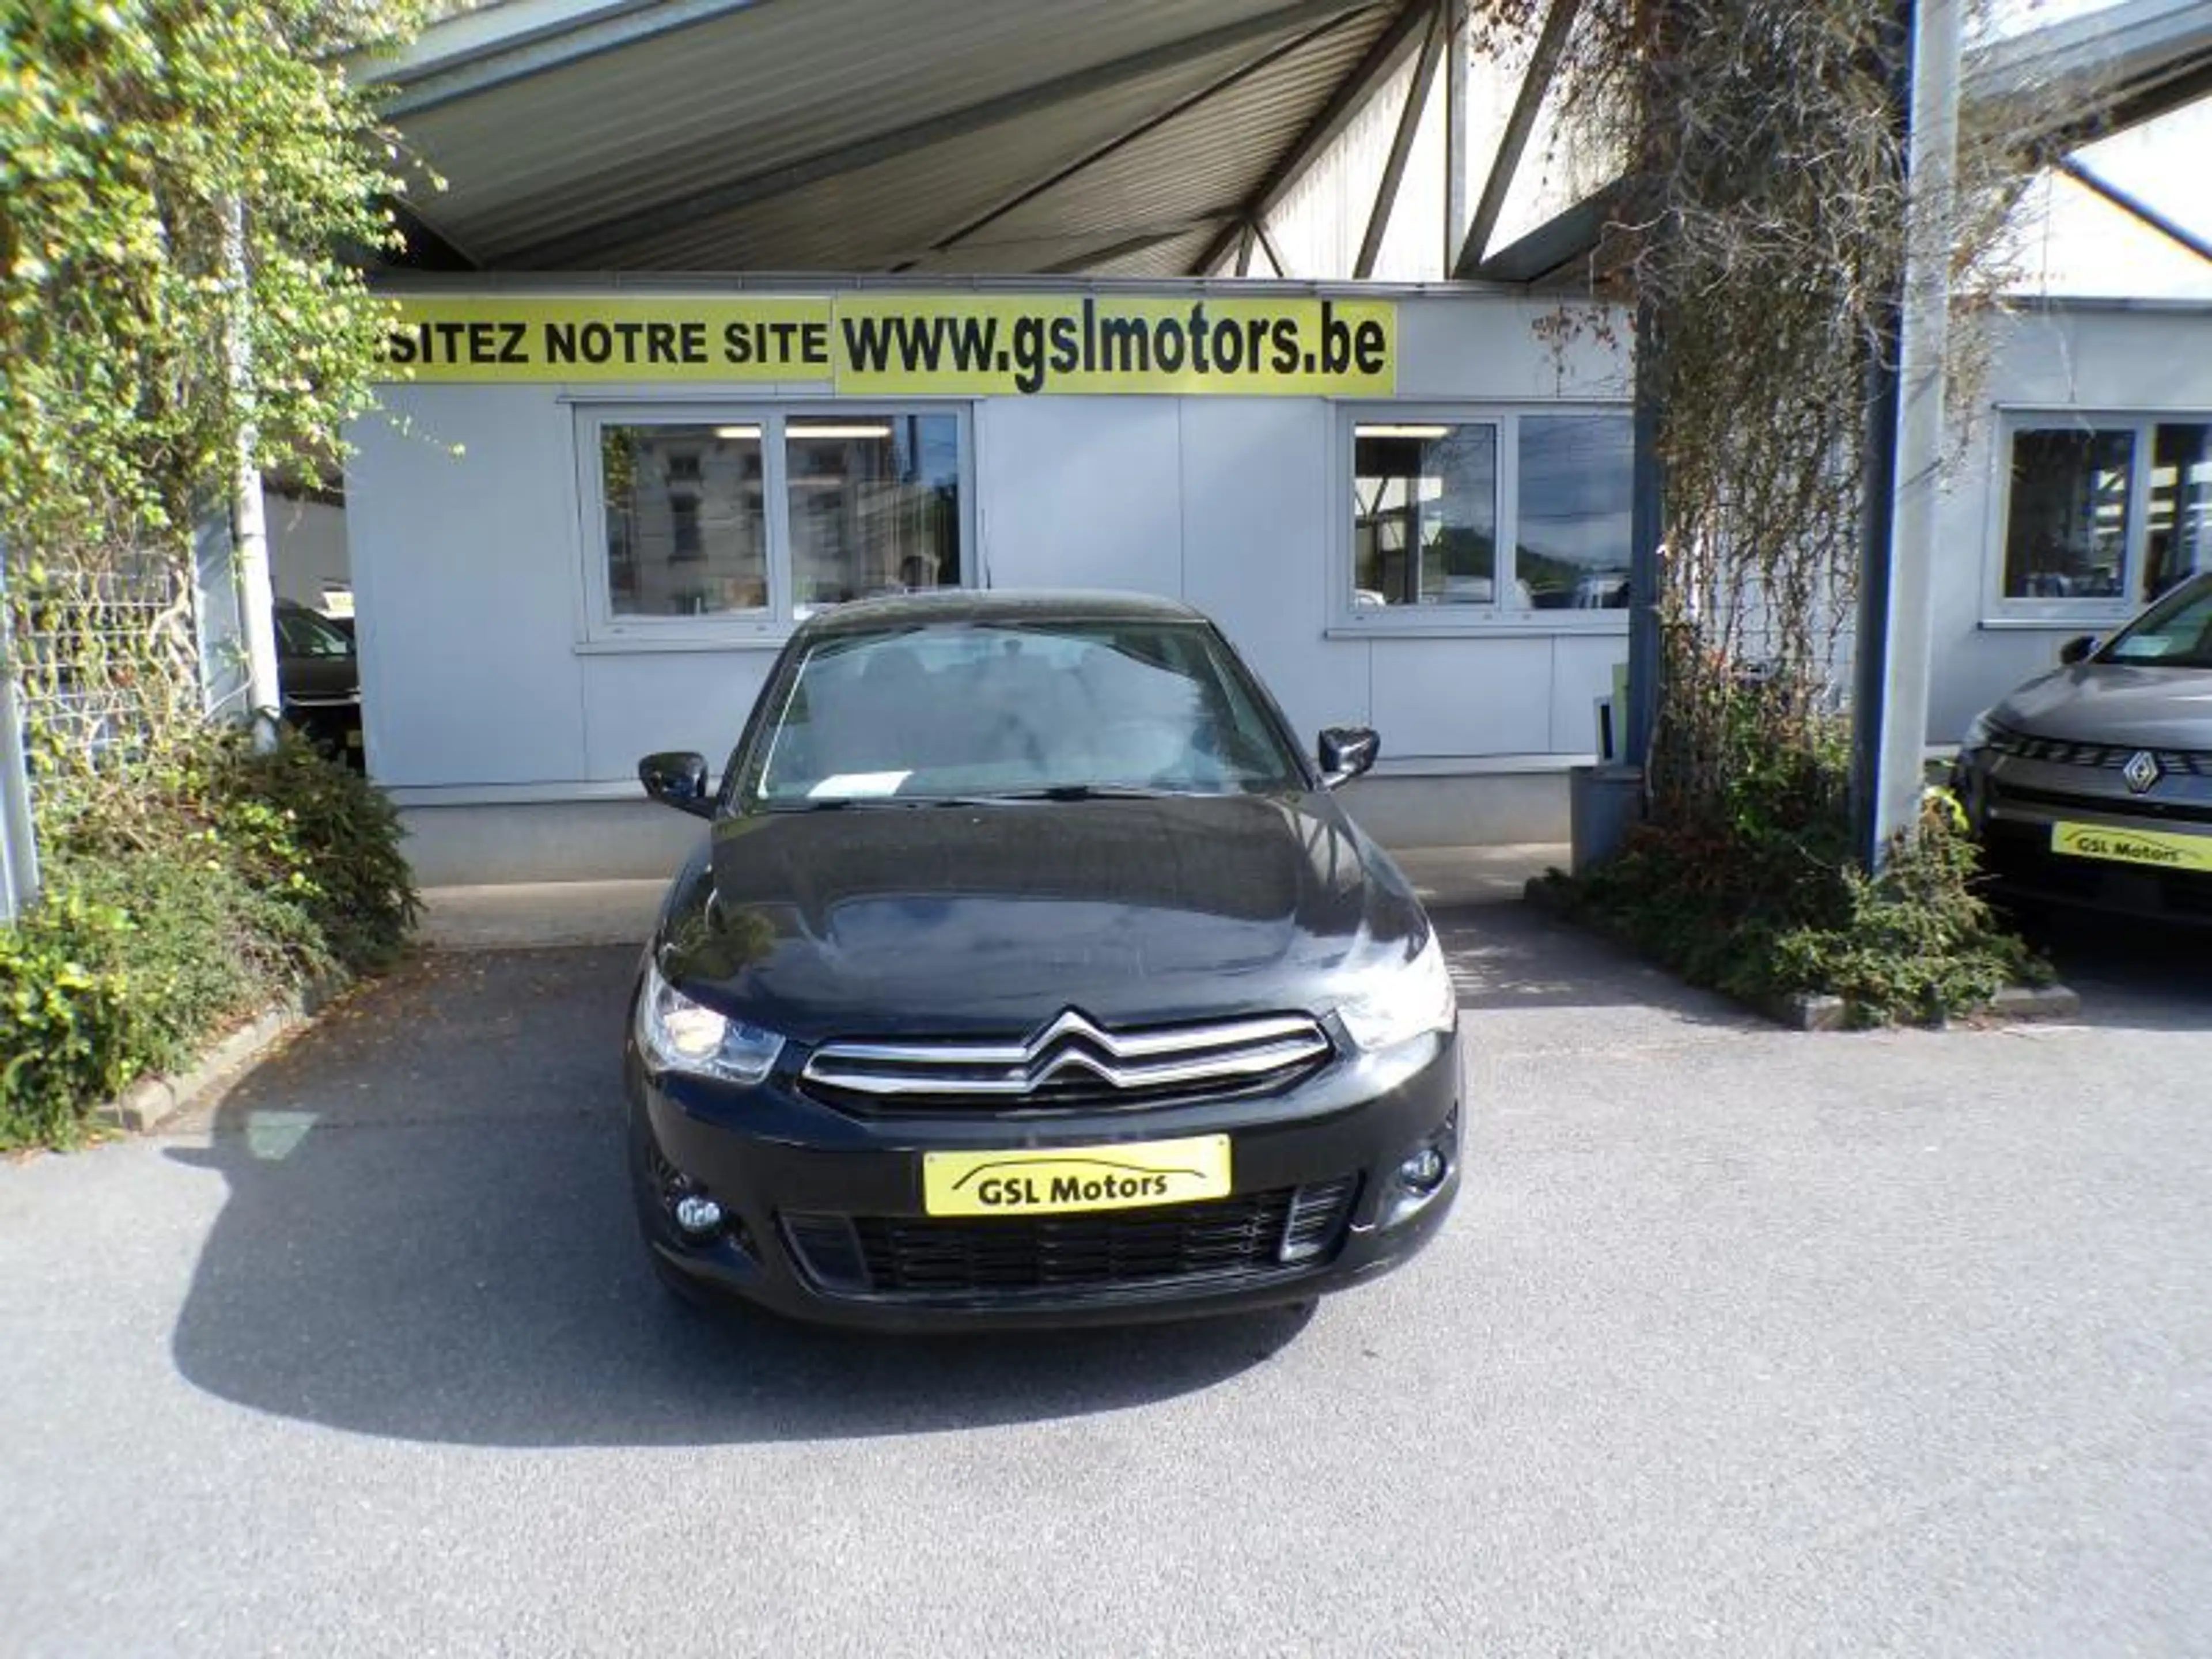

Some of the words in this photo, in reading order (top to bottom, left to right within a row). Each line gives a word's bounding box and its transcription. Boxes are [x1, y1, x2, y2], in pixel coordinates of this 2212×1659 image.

[545, 323, 707, 363] NOTRE
[724, 323, 828, 363] SITE
[842, 298, 1385, 394] www.gslmotors.be
[979, 1177, 1038, 1205] GSL
[1050, 1174, 1168, 1203] Motors
